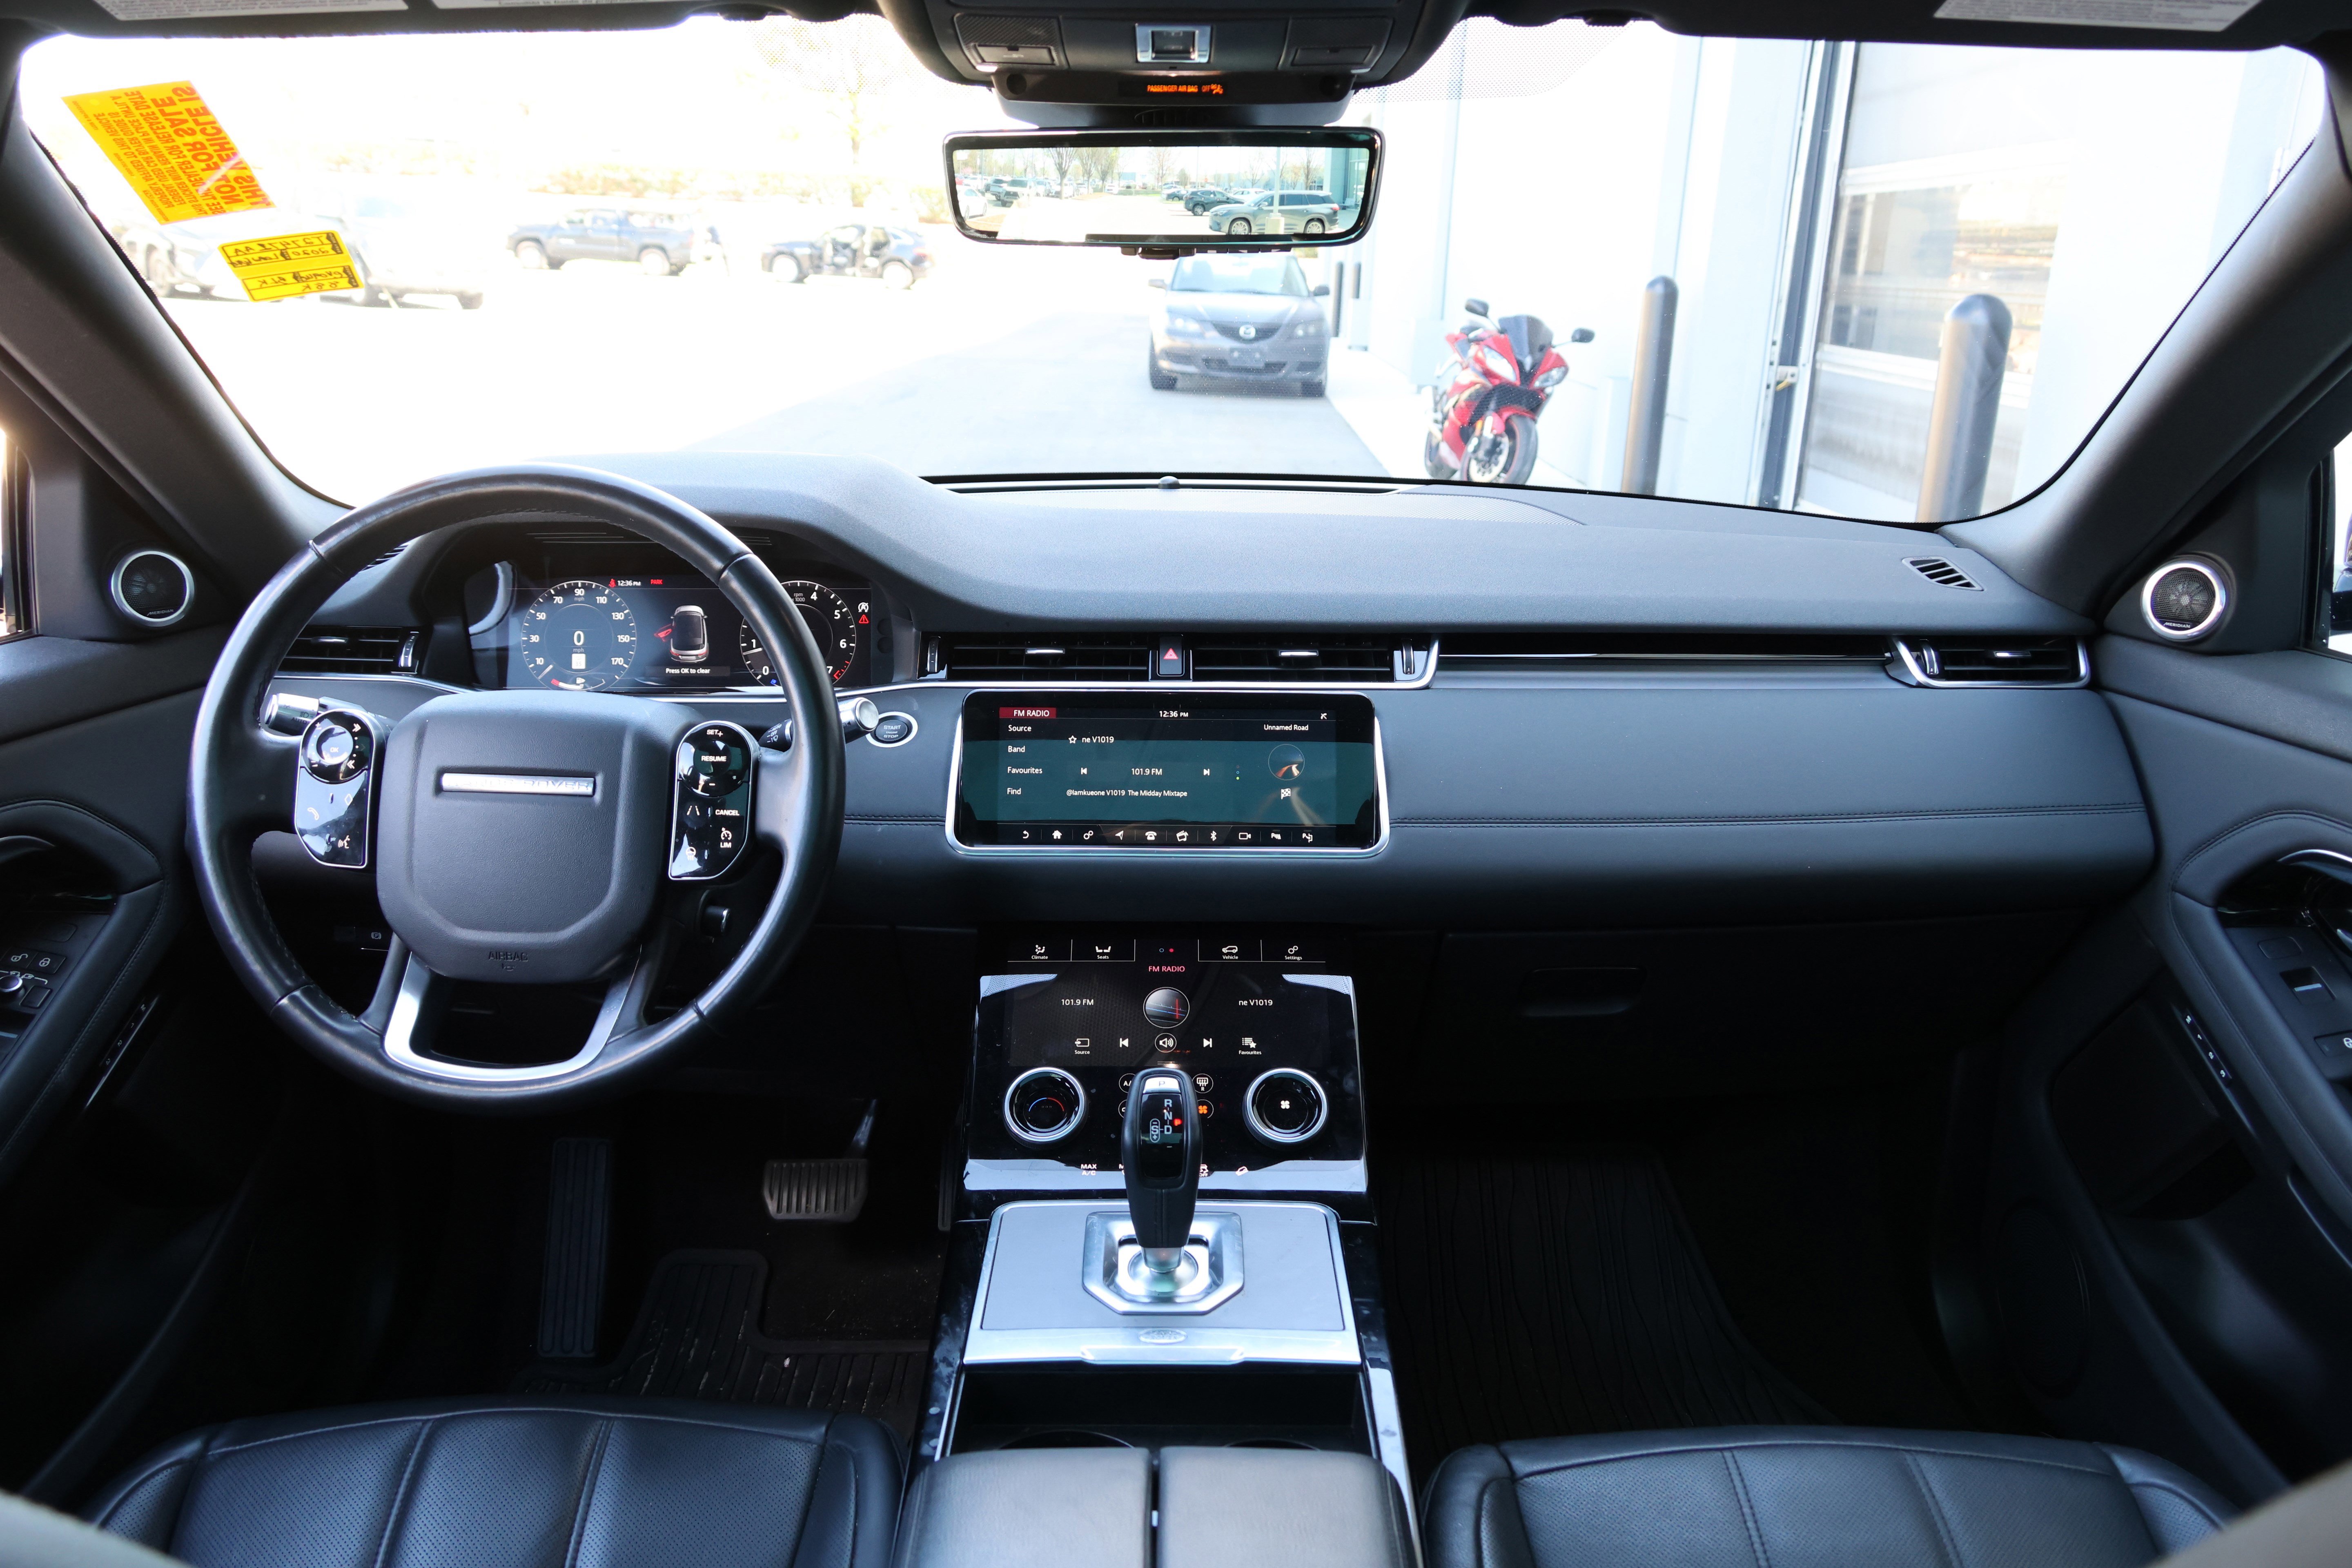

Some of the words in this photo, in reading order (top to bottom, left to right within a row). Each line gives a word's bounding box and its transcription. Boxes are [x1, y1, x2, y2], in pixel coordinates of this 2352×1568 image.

[810, 592, 817, 601] 4
[834, 610, 840, 619] 5
[529, 635, 539, 643] 30
[573, 630, 584, 646] 0
[617, 635, 630, 643] 150
[751, 639, 756, 648] 1
[840, 639, 846, 648] 6
[762, 666, 769, 675] 0
[488, 951, 528, 962] AIRBAG
[2209, 1051, 2214, 1060] 2
[1164, 1099, 1172, 1107] R
[1151, 1125, 1158, 1134] S
[1164, 1126, 1172, 1134] D
